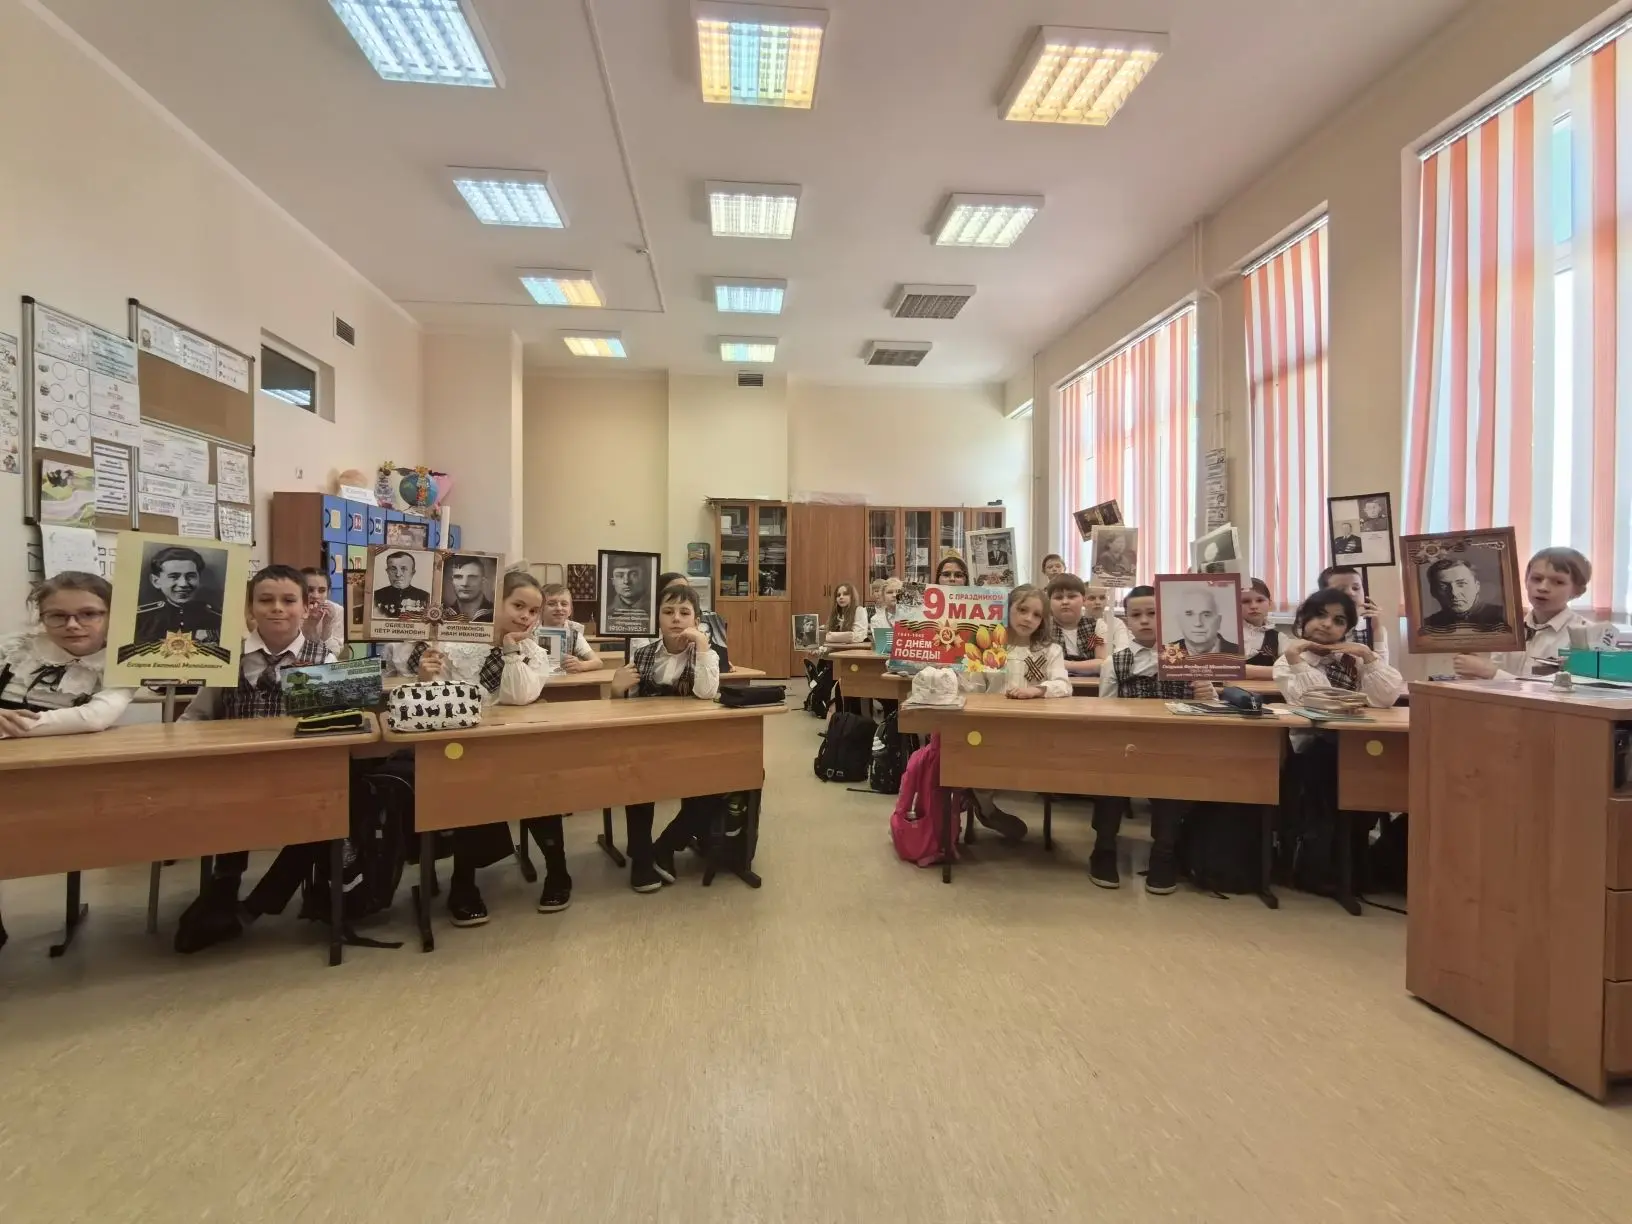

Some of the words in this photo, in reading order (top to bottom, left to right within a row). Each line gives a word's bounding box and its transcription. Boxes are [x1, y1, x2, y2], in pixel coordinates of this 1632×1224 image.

[923, 587, 945, 619] 9
[948, 604, 1004, 620] МАЯ
[896, 638, 903, 647] С
[904, 638, 932, 649] ДНЁМ
[894, 648, 940, 661] ПОБЕДЫ!
